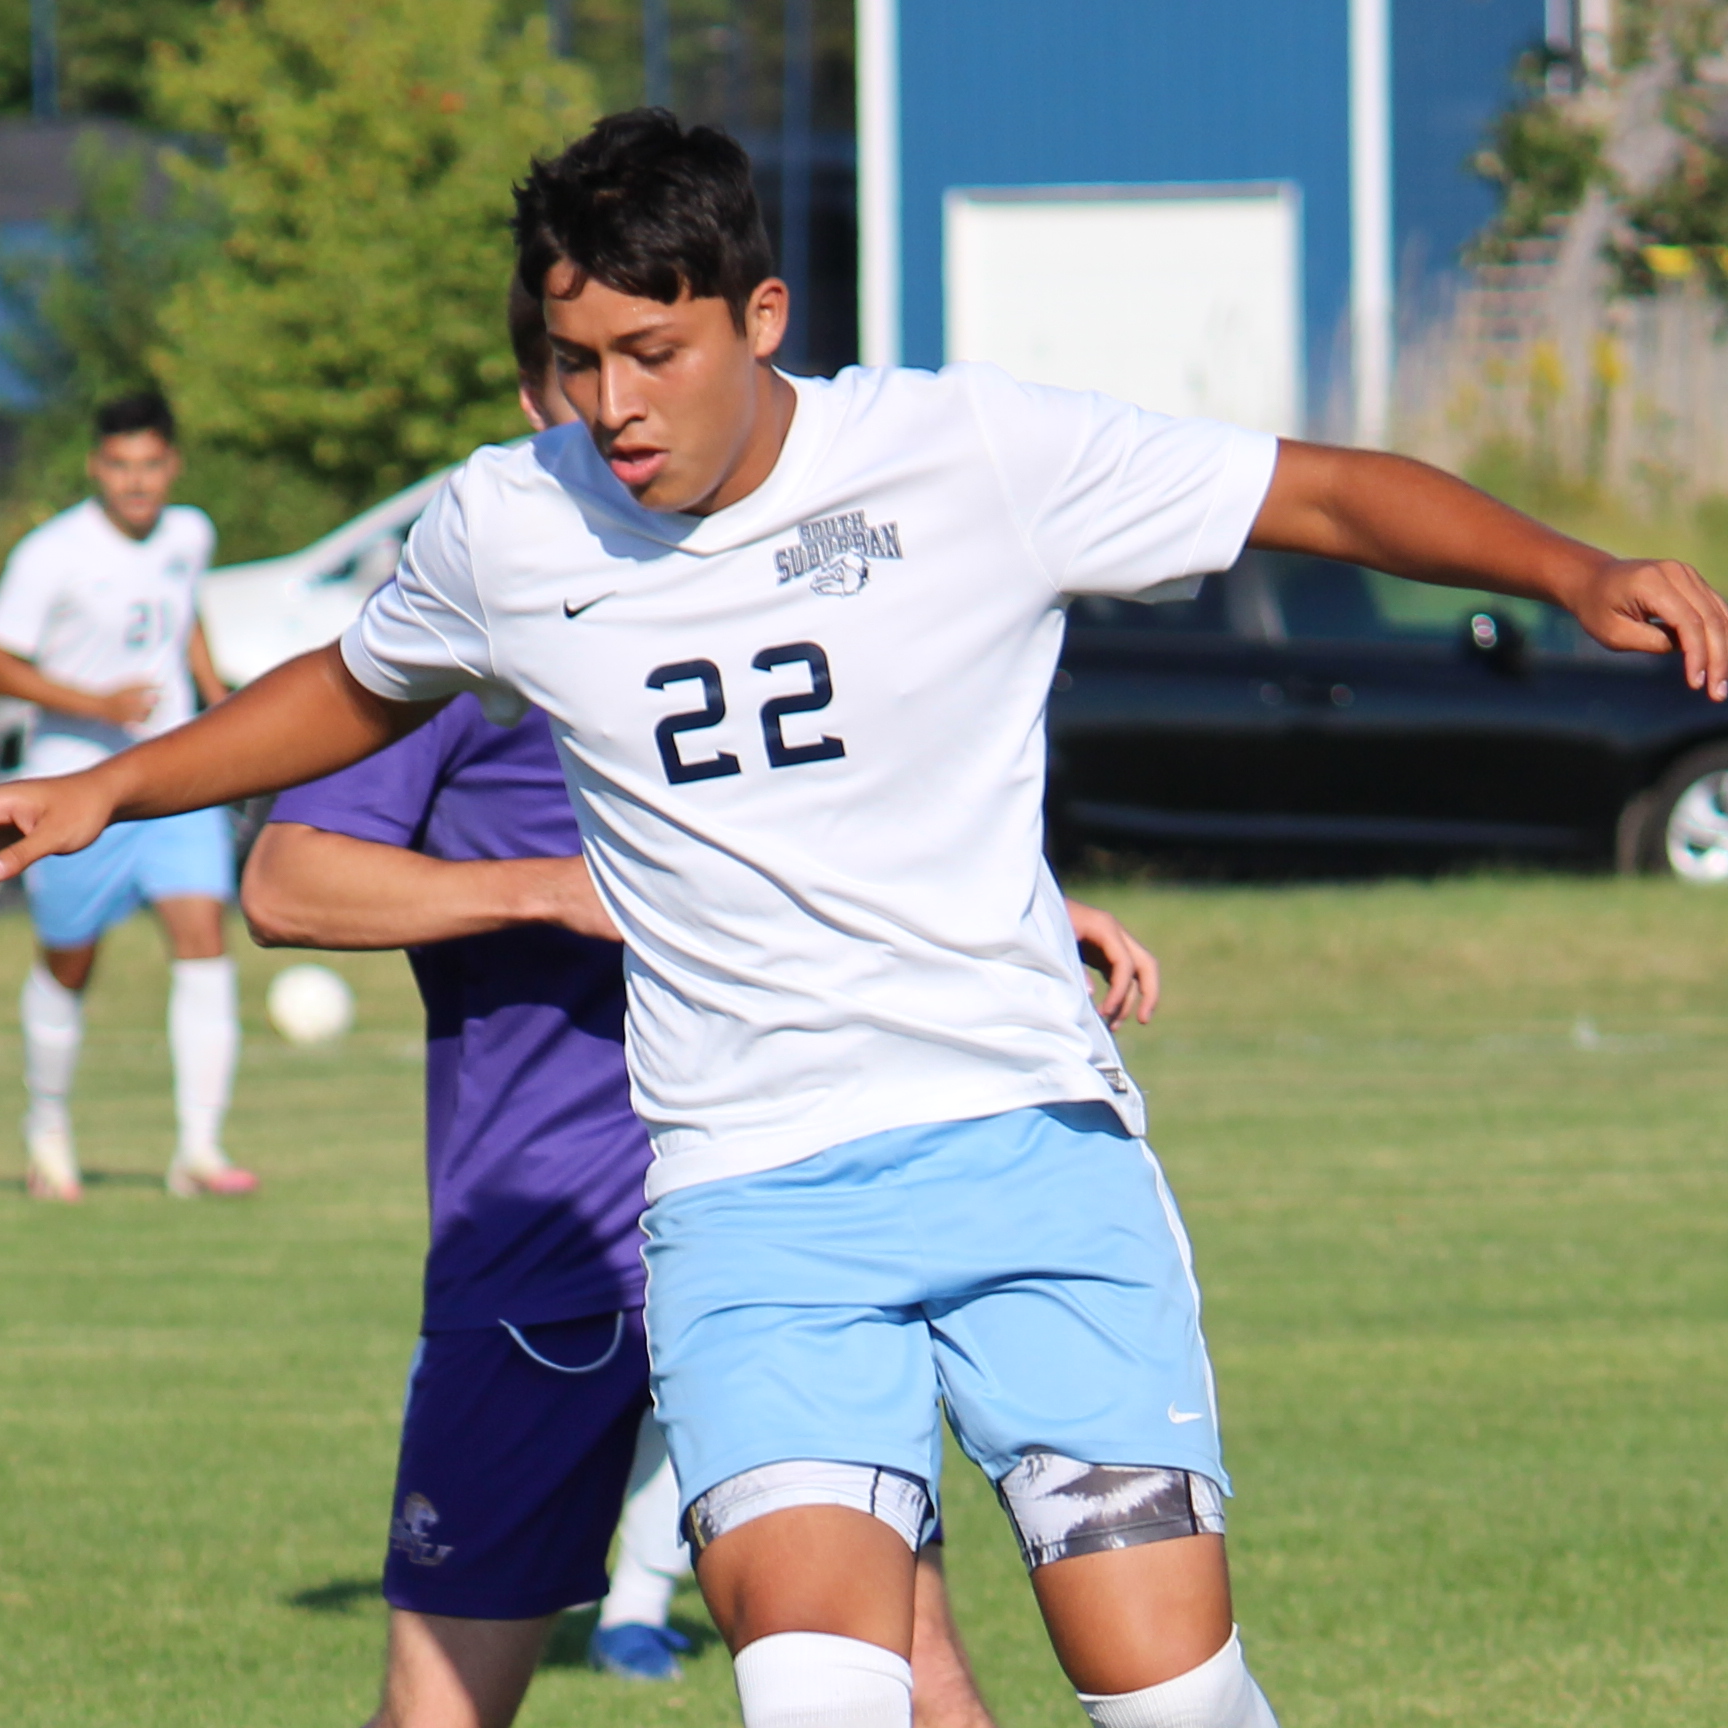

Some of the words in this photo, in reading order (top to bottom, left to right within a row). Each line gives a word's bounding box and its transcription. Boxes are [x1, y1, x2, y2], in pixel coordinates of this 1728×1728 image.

[774, 521, 903, 586] SUBURBAN
[798, 509, 867, 541] SOUTH
[645, 641, 846, 784] 22
